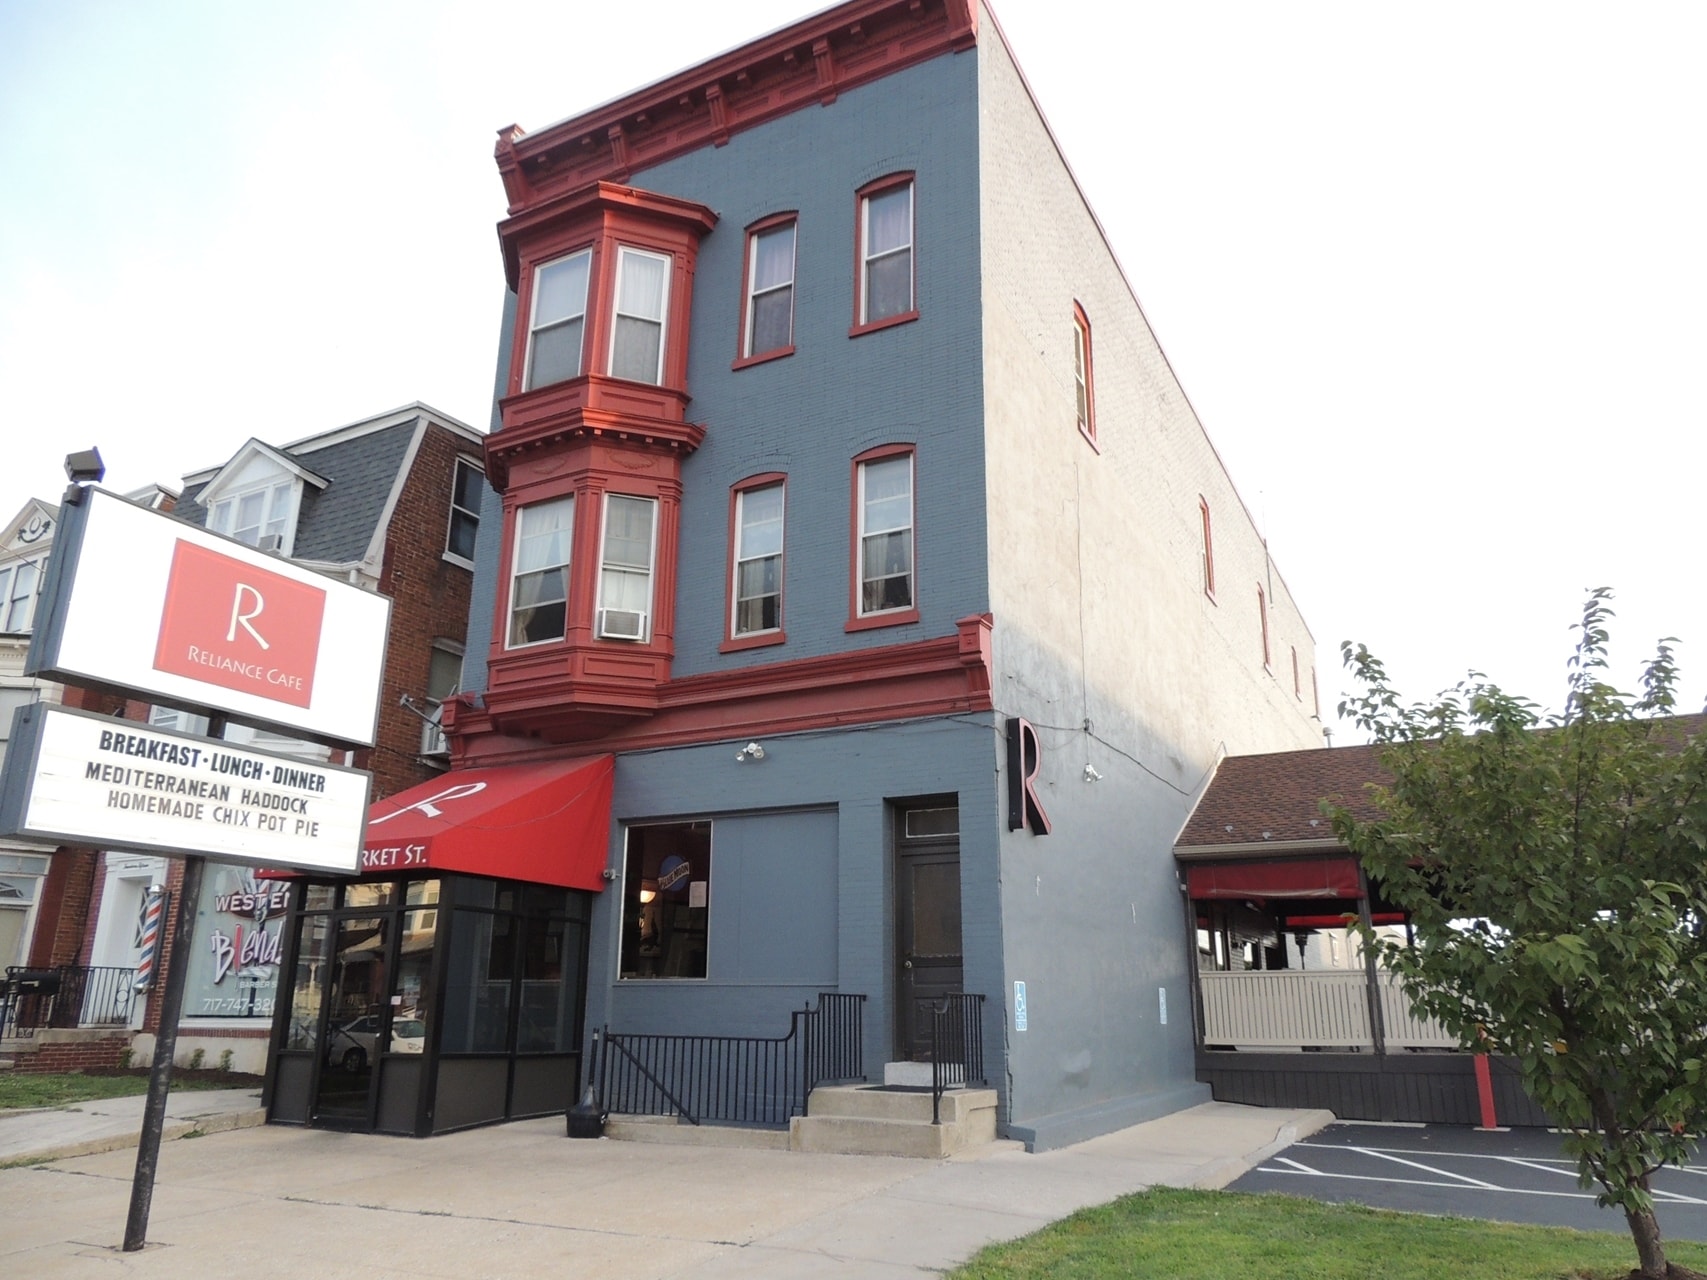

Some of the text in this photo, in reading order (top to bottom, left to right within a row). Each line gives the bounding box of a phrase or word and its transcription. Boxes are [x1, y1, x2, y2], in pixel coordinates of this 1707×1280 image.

[226, 582, 270, 650] R
[187, 645, 303, 690] RELIANCE CAFE
[99, 729, 326, 793] BREAKFAST LUNCH DINNER
[1006, 717, 1052, 836] R
[85, 761, 308, 815] MEDITERRANEAN HADDOCK
[107, 790, 319, 837] HOMEMADE CHIX POT PIE
[362, 844, 427, 866] RKET ST.
[215, 894, 268, 912] WEST
[203, 997, 275, 1012] 717-747-32
